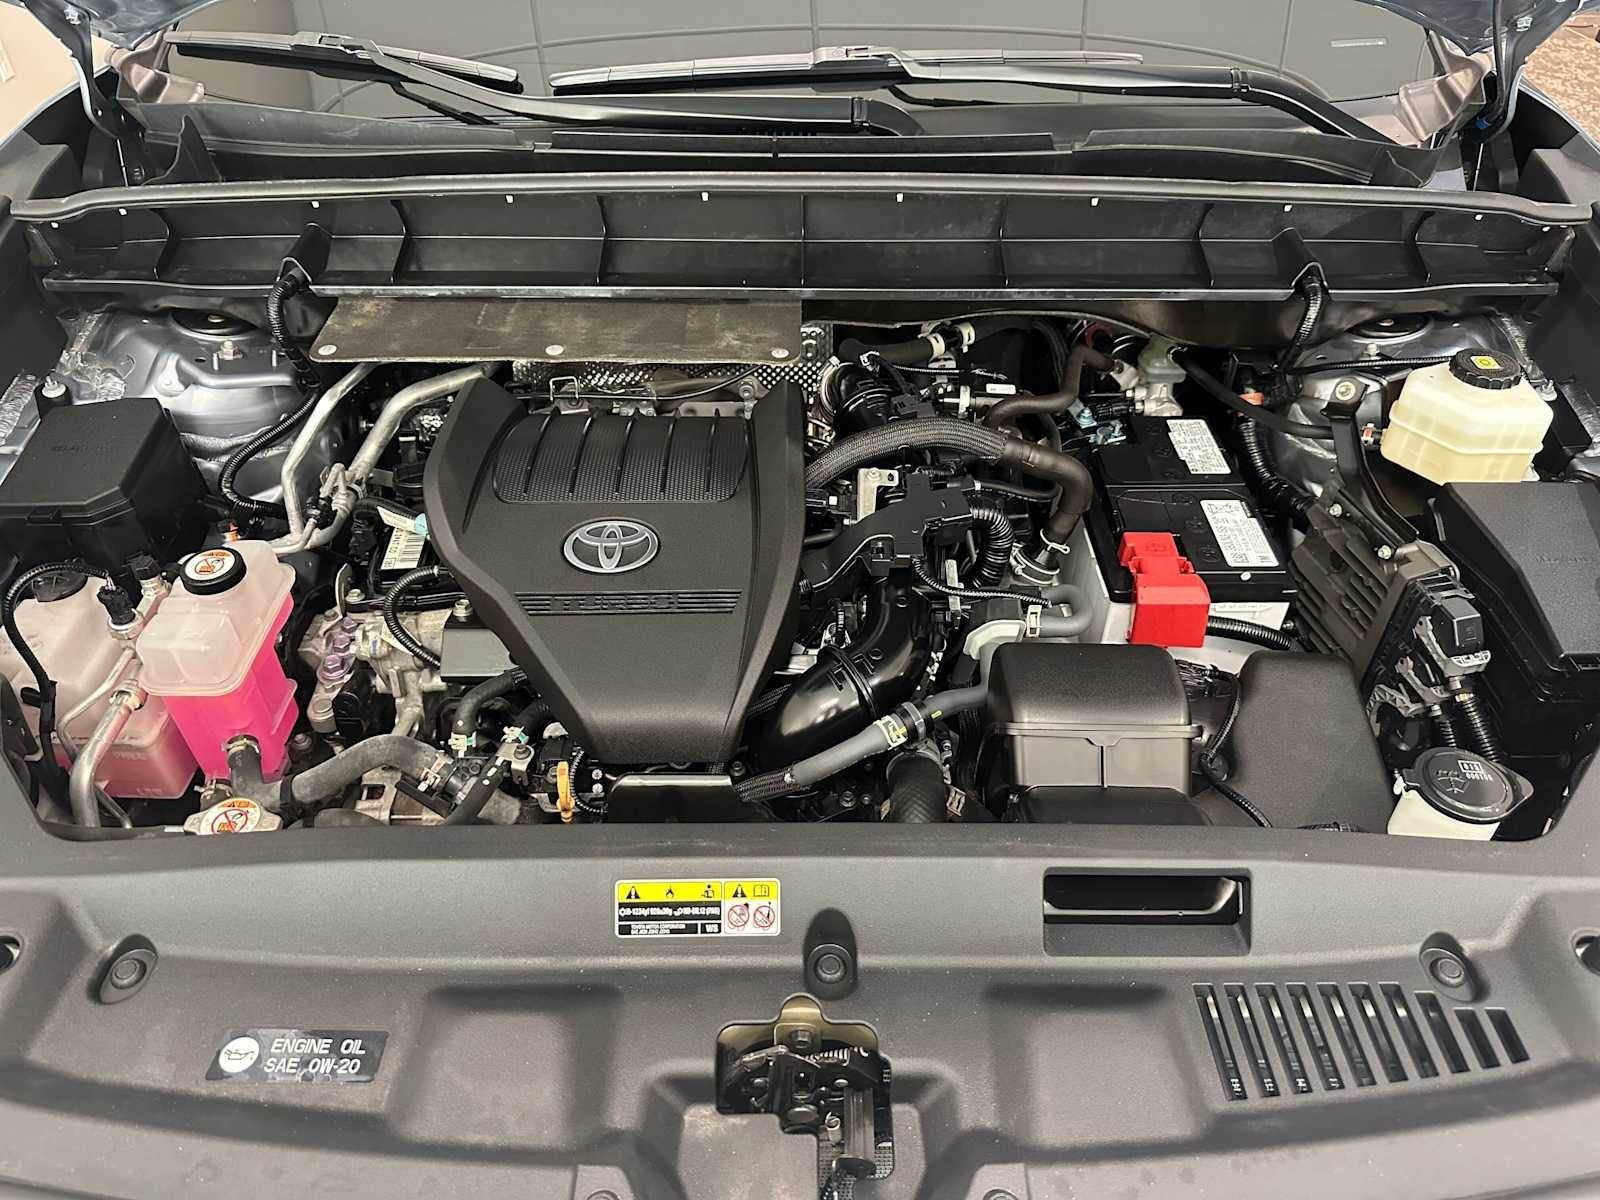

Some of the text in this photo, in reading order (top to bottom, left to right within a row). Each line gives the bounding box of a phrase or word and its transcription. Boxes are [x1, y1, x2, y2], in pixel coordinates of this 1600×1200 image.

[550, 594, 679, 610] TURBO
[271, 1039, 366, 1055] ENGINE OIL
[263, 1057, 361, 1074] SAE 0W-20
